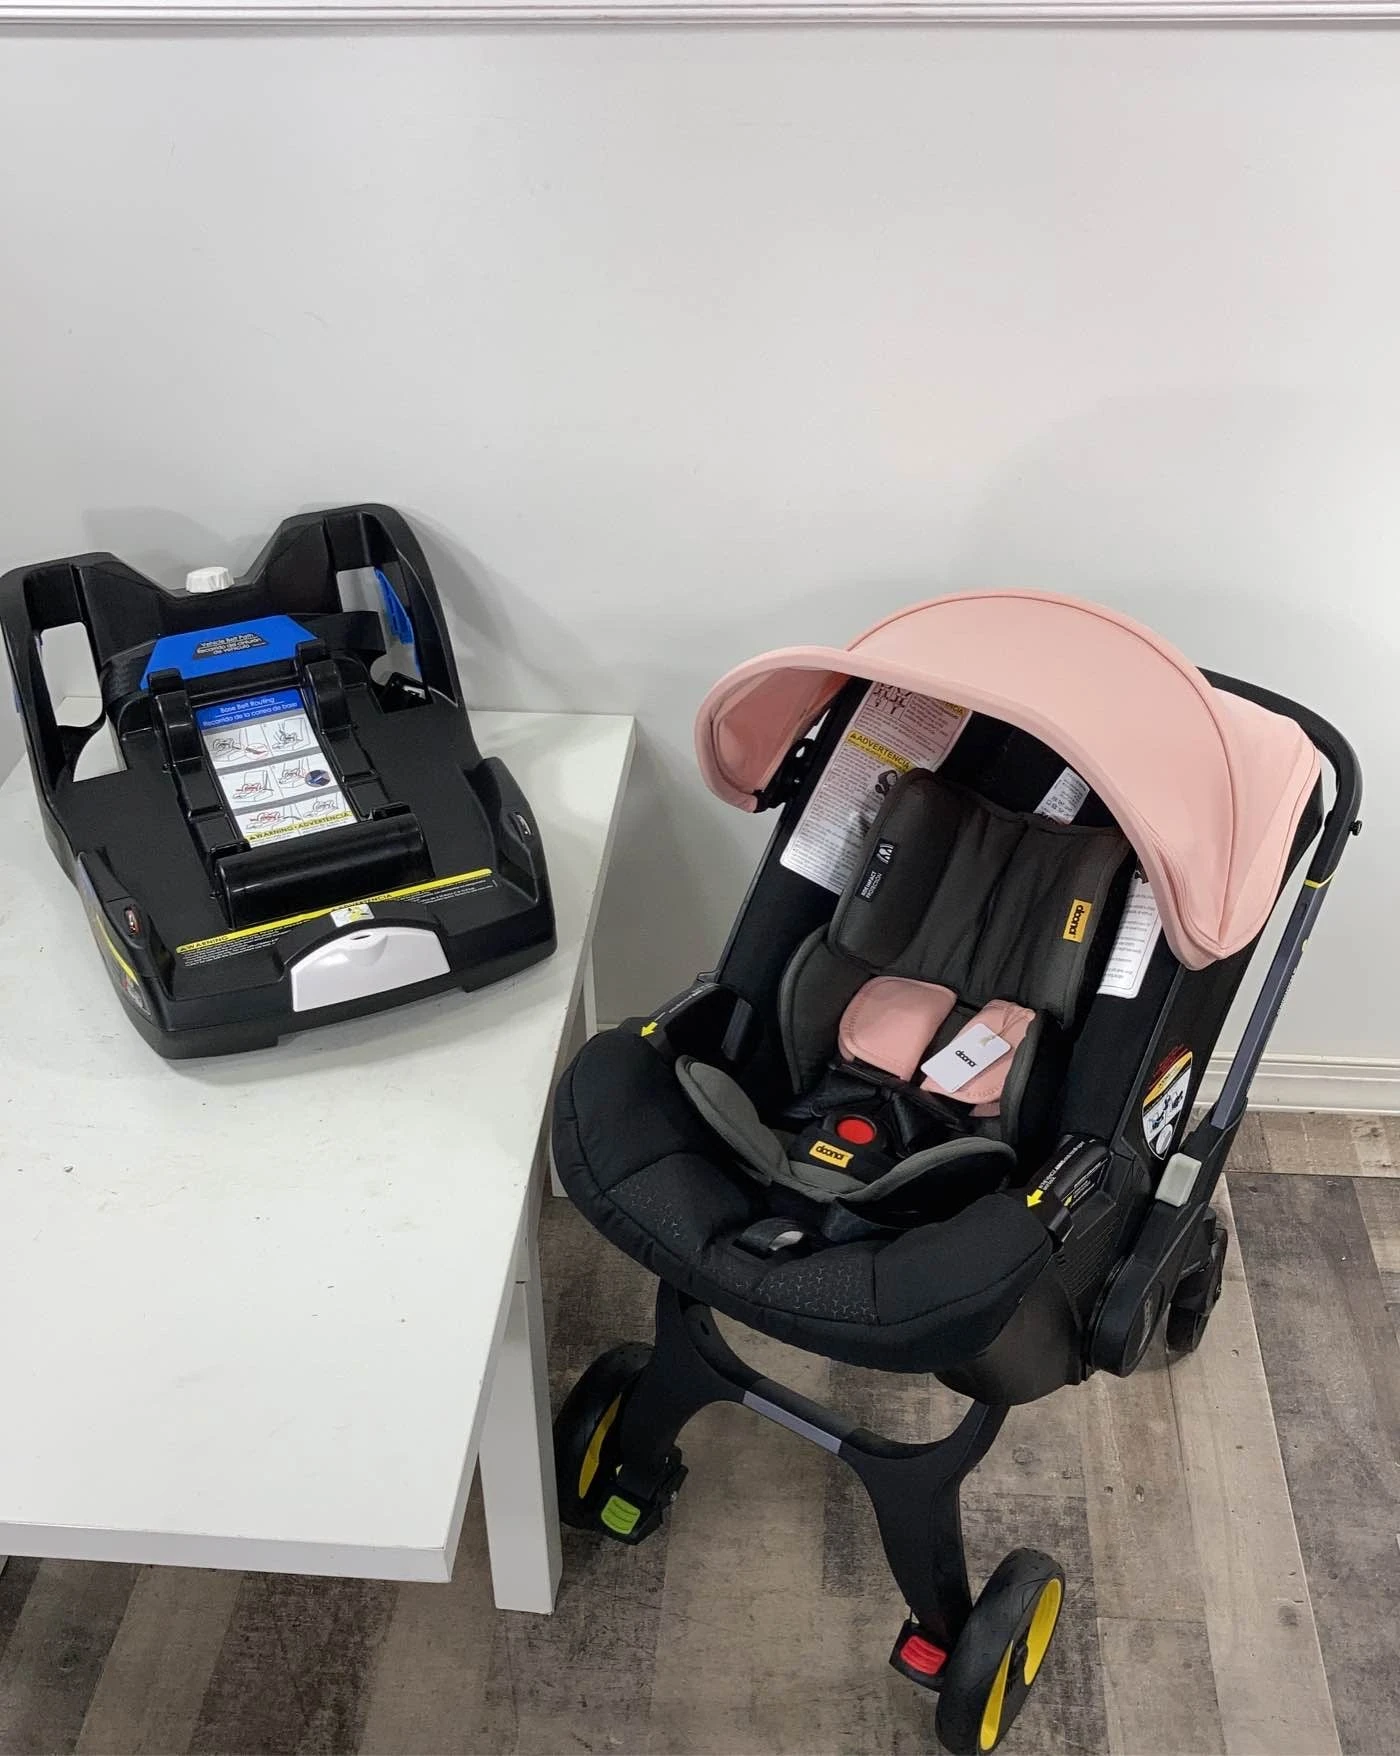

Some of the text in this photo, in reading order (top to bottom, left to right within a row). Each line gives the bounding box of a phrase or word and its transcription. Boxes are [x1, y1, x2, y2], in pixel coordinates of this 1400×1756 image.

[203, 716, 233, 727] Recorrido
[251, 707, 272, 717] correa
[281, 702, 298, 710] base
[220, 697, 275, 714] Base Belt Routing
[857, 734, 911, 769] ADVERTENCIA
[255, 825, 294, 839] WARNING
[298, 812, 351, 830] ADVERTENCIA
[1069, 904, 1085, 935] doona
[186, 935, 230, 949] WARNING
[955, 1049, 977, 1068] doona
[815, 1145, 844, 1161] doona
